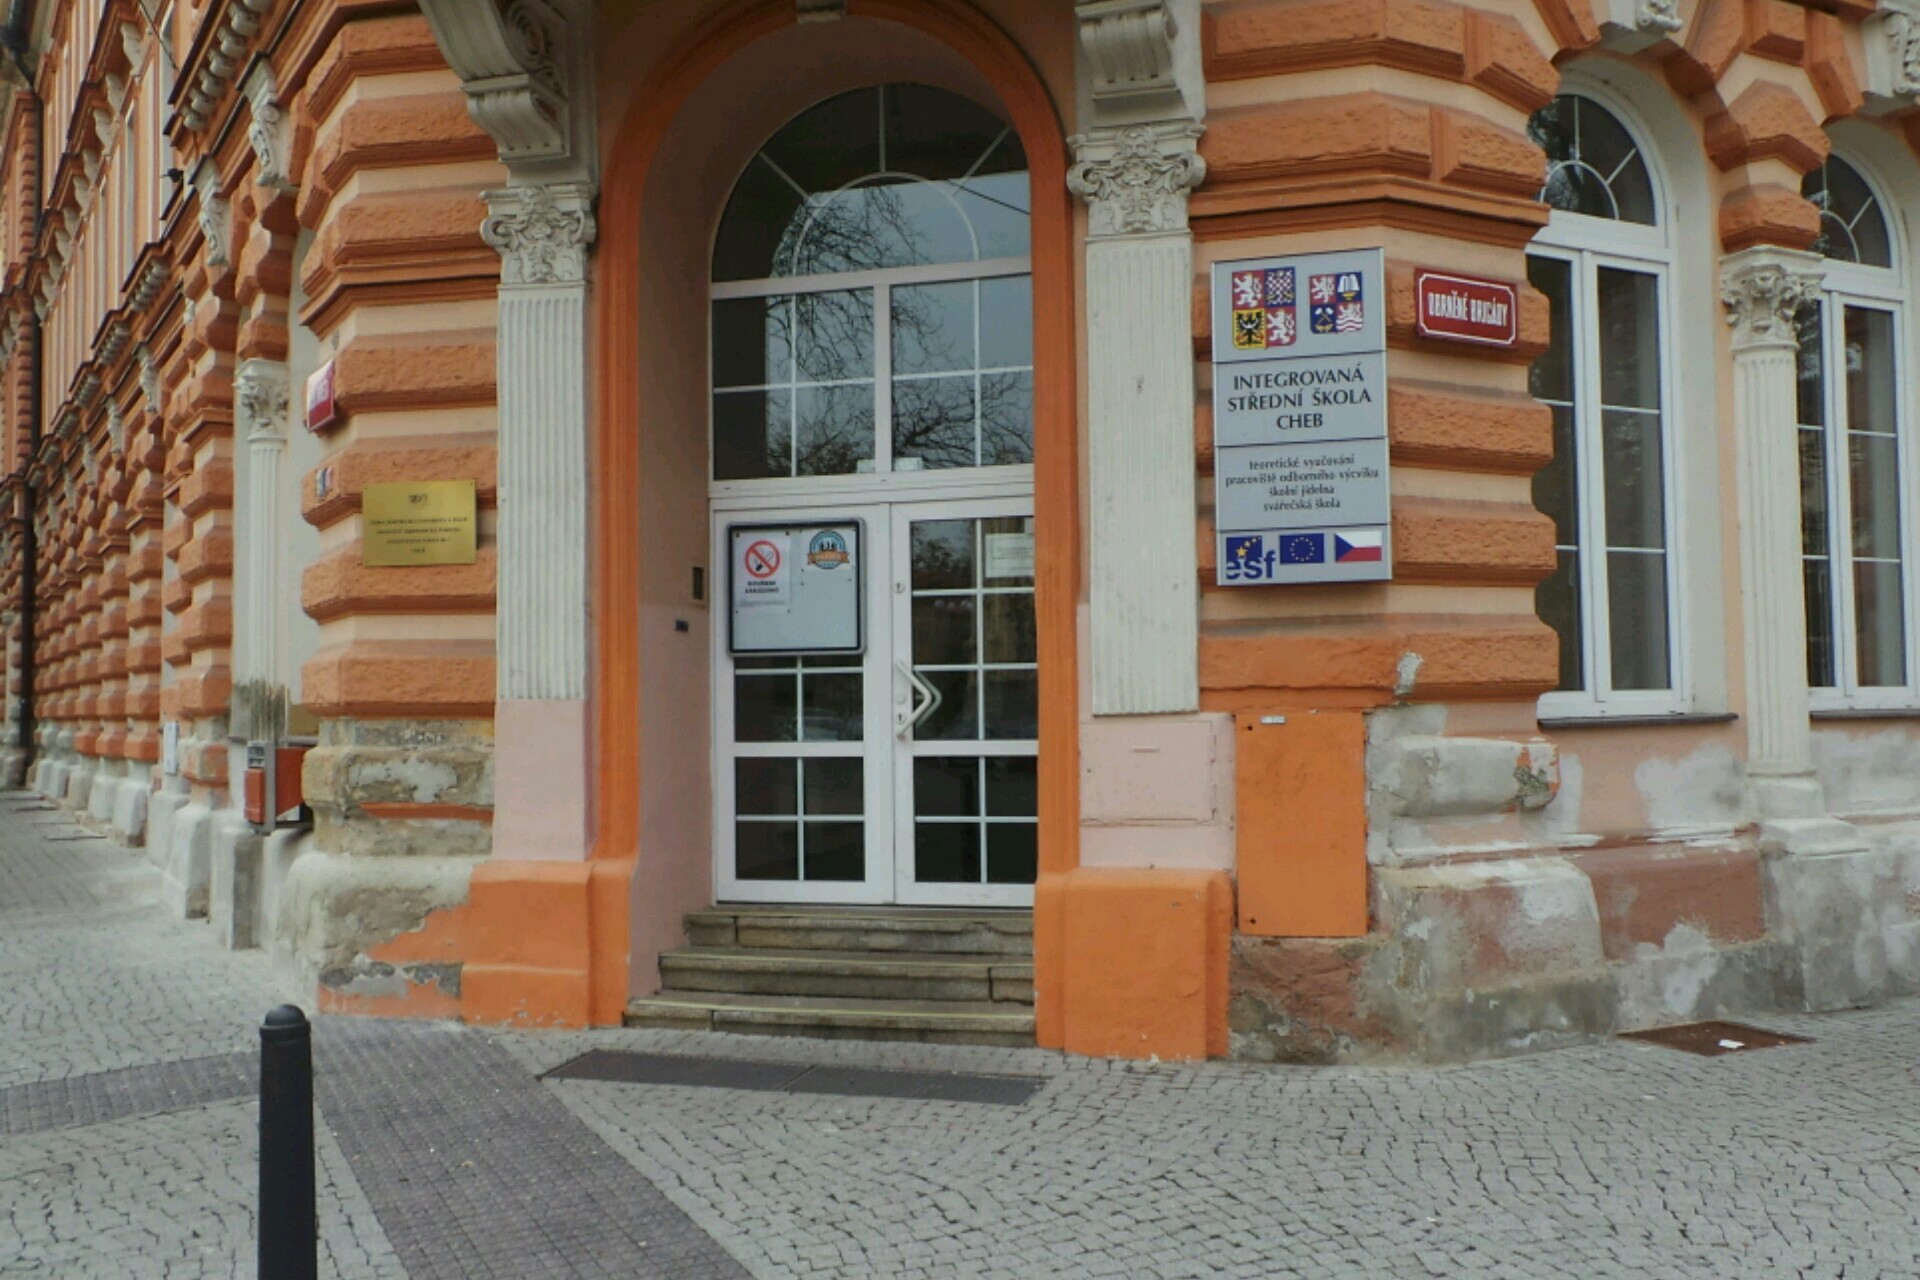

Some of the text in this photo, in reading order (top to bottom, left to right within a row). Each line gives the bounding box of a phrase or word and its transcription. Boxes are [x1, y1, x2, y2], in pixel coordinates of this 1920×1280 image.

[1233, 362, 1364, 390] INTEGROVANÁ
[1227, 387, 1372, 412] STŘEDNÍ ŠKOLA
[1276, 413, 1323, 430] CHEB
[1249, 453, 1355, 471] teoretické vyučování
[1315, 498, 1341, 509] škola
[1226, 549, 1276, 580] esf
